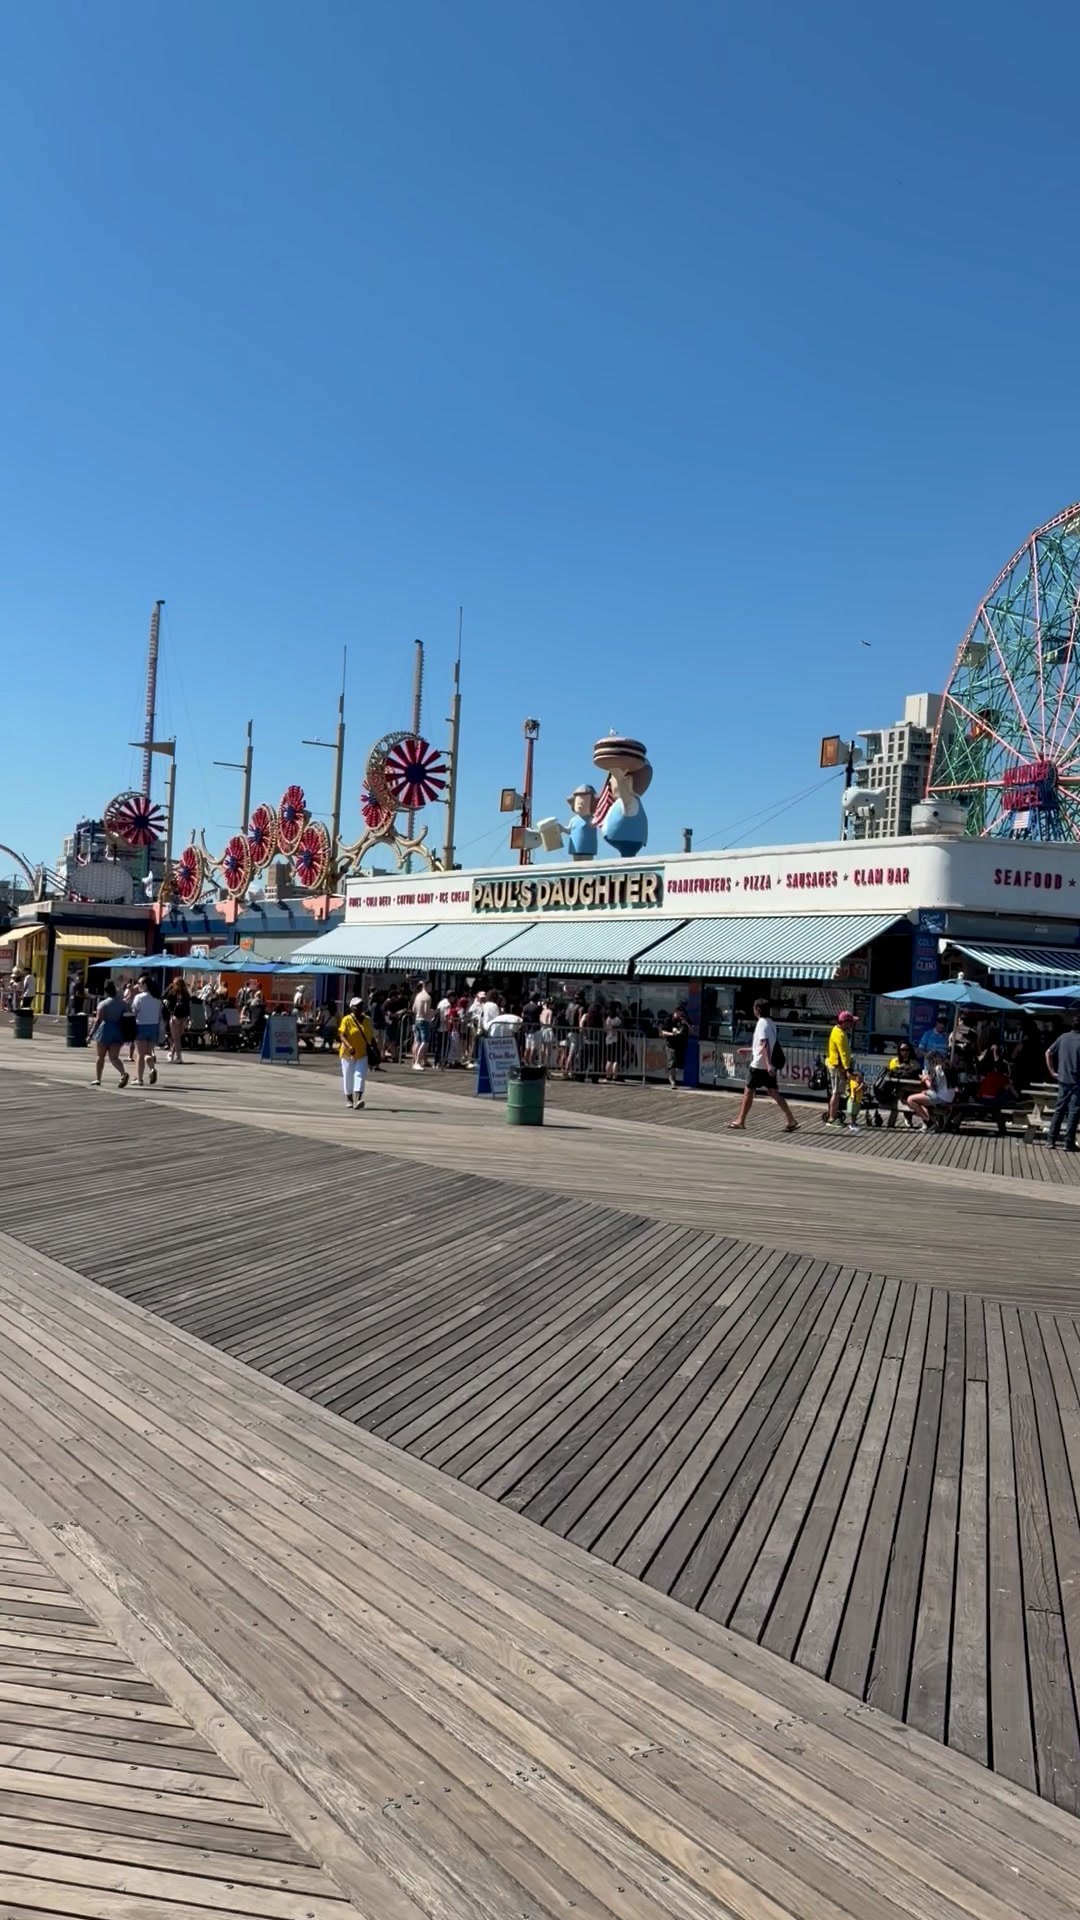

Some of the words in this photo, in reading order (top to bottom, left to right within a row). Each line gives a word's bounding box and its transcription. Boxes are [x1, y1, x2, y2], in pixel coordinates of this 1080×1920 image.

[472, 879, 533, 909] PAUL'S
[535, 872, 660, 906] DAUGHTER
[667, 877, 732, 893] FRANKFURTERS
[743, 874, 771, 891] PIZZA
[786, 871, 838, 889] SAUSAGES
[854, 868, 883, 887] CLAM
[887, 867, 910, 886] BAR
[994, 868, 1063, 890] SEAFOOD
[440, 892, 449, 904] ICE
[451, 890, 470, 903] CREAM
